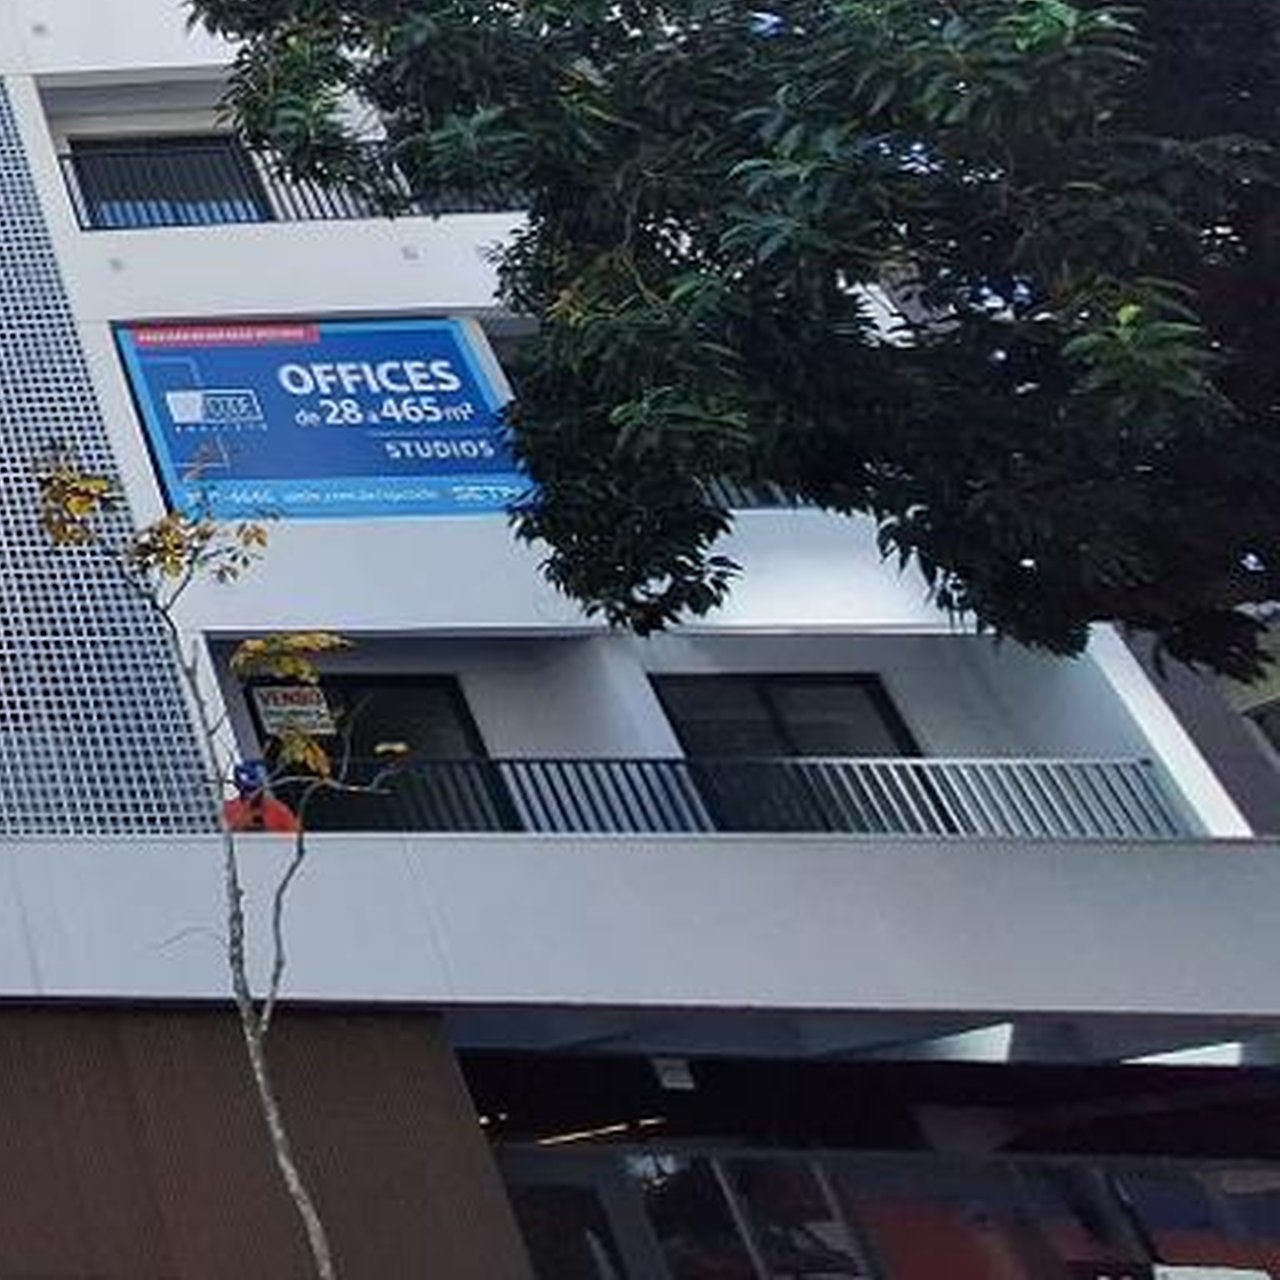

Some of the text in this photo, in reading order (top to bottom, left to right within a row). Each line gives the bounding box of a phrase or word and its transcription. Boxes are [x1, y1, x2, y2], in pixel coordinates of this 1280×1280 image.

[278, 360, 461, 395] OFFICES
[320, 399, 364, 425] 28
[386, 439, 495, 458] STUDIOS
